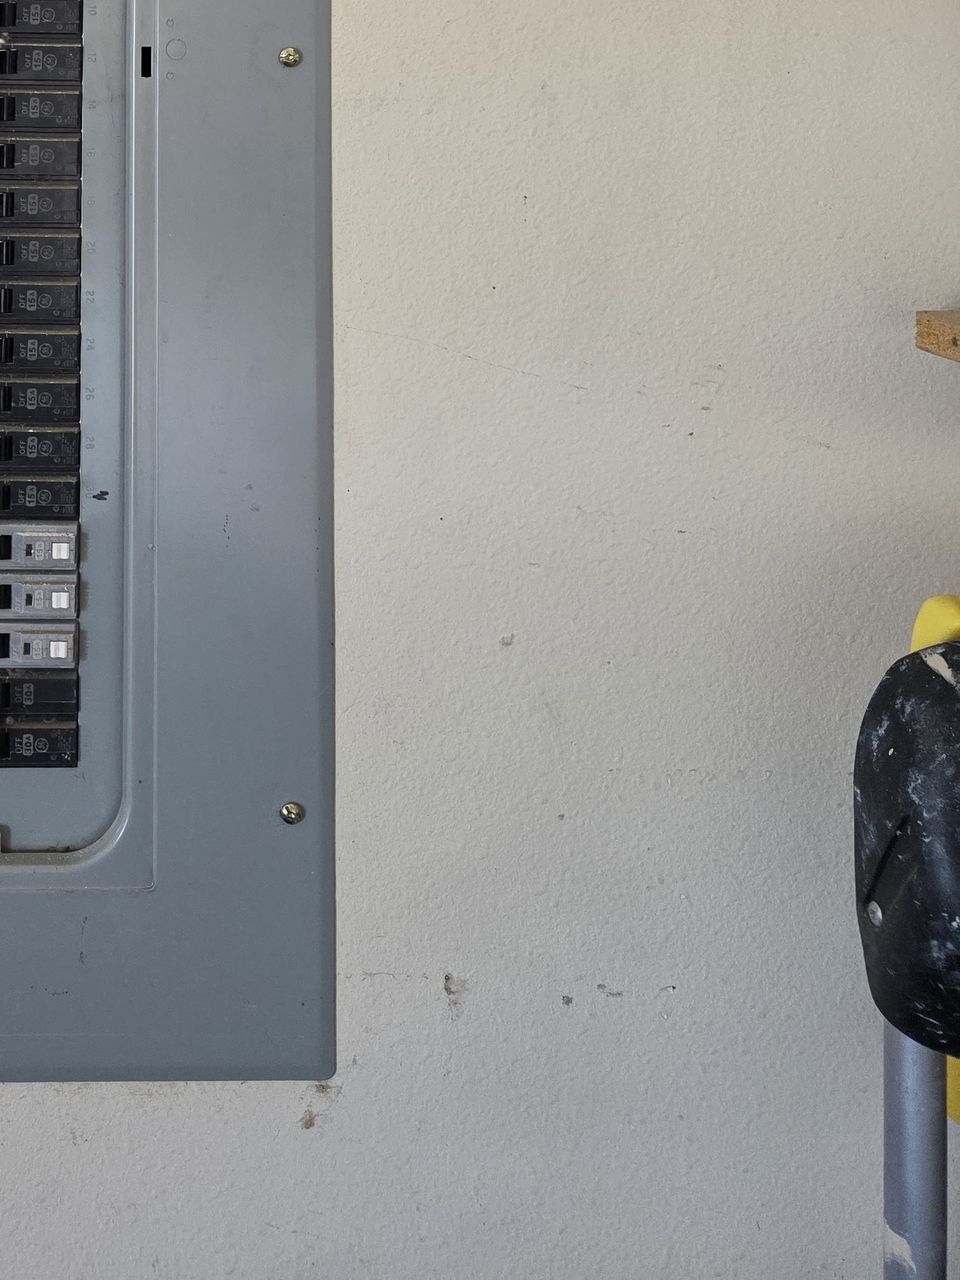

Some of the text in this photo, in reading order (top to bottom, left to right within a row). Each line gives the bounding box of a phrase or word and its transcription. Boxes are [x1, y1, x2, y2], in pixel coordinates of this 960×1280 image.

[27, 340, 37, 360] 15A
[27, 389, 37, 409] 15A
[27, 437, 37, 457] 15A
[27, 486, 36, 506] 15A
[24, 684, 34, 704] 30A
[24, 734, 33, 755] 30A
